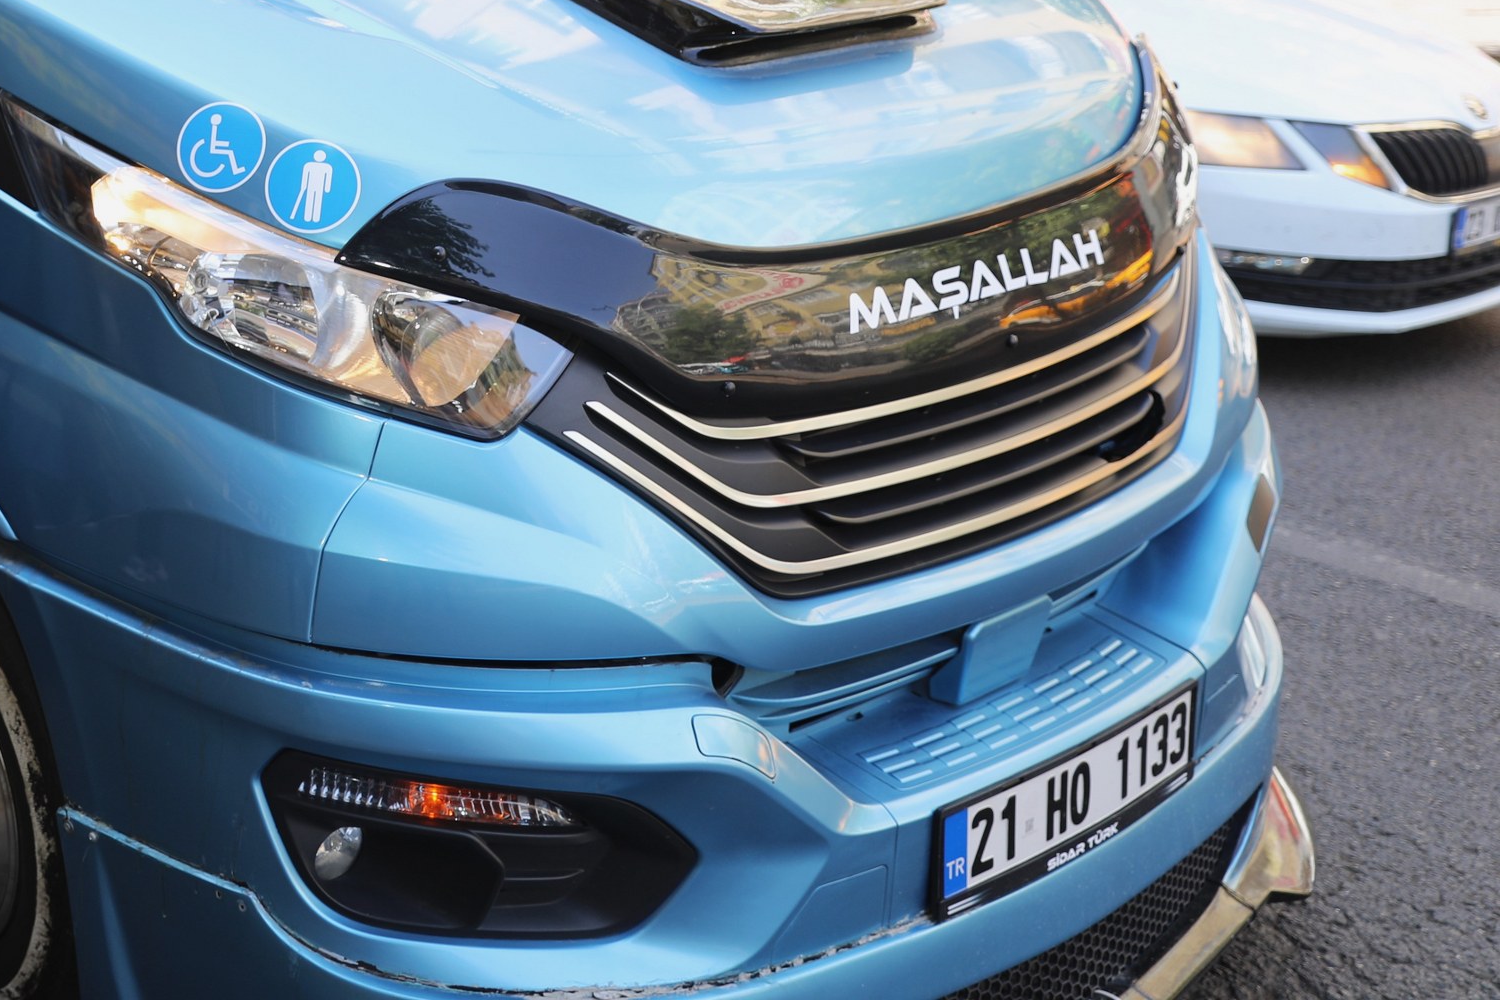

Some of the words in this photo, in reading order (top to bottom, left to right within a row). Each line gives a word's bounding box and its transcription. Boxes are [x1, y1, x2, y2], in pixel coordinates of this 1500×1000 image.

[849, 229, 1105, 334] MAŞALLAH
[971, 795, 1017, 878] 21
[1046, 761, 1091, 841] HO
[1117, 702, 1188, 800] 1133
[946, 857, 966, 880] TR
